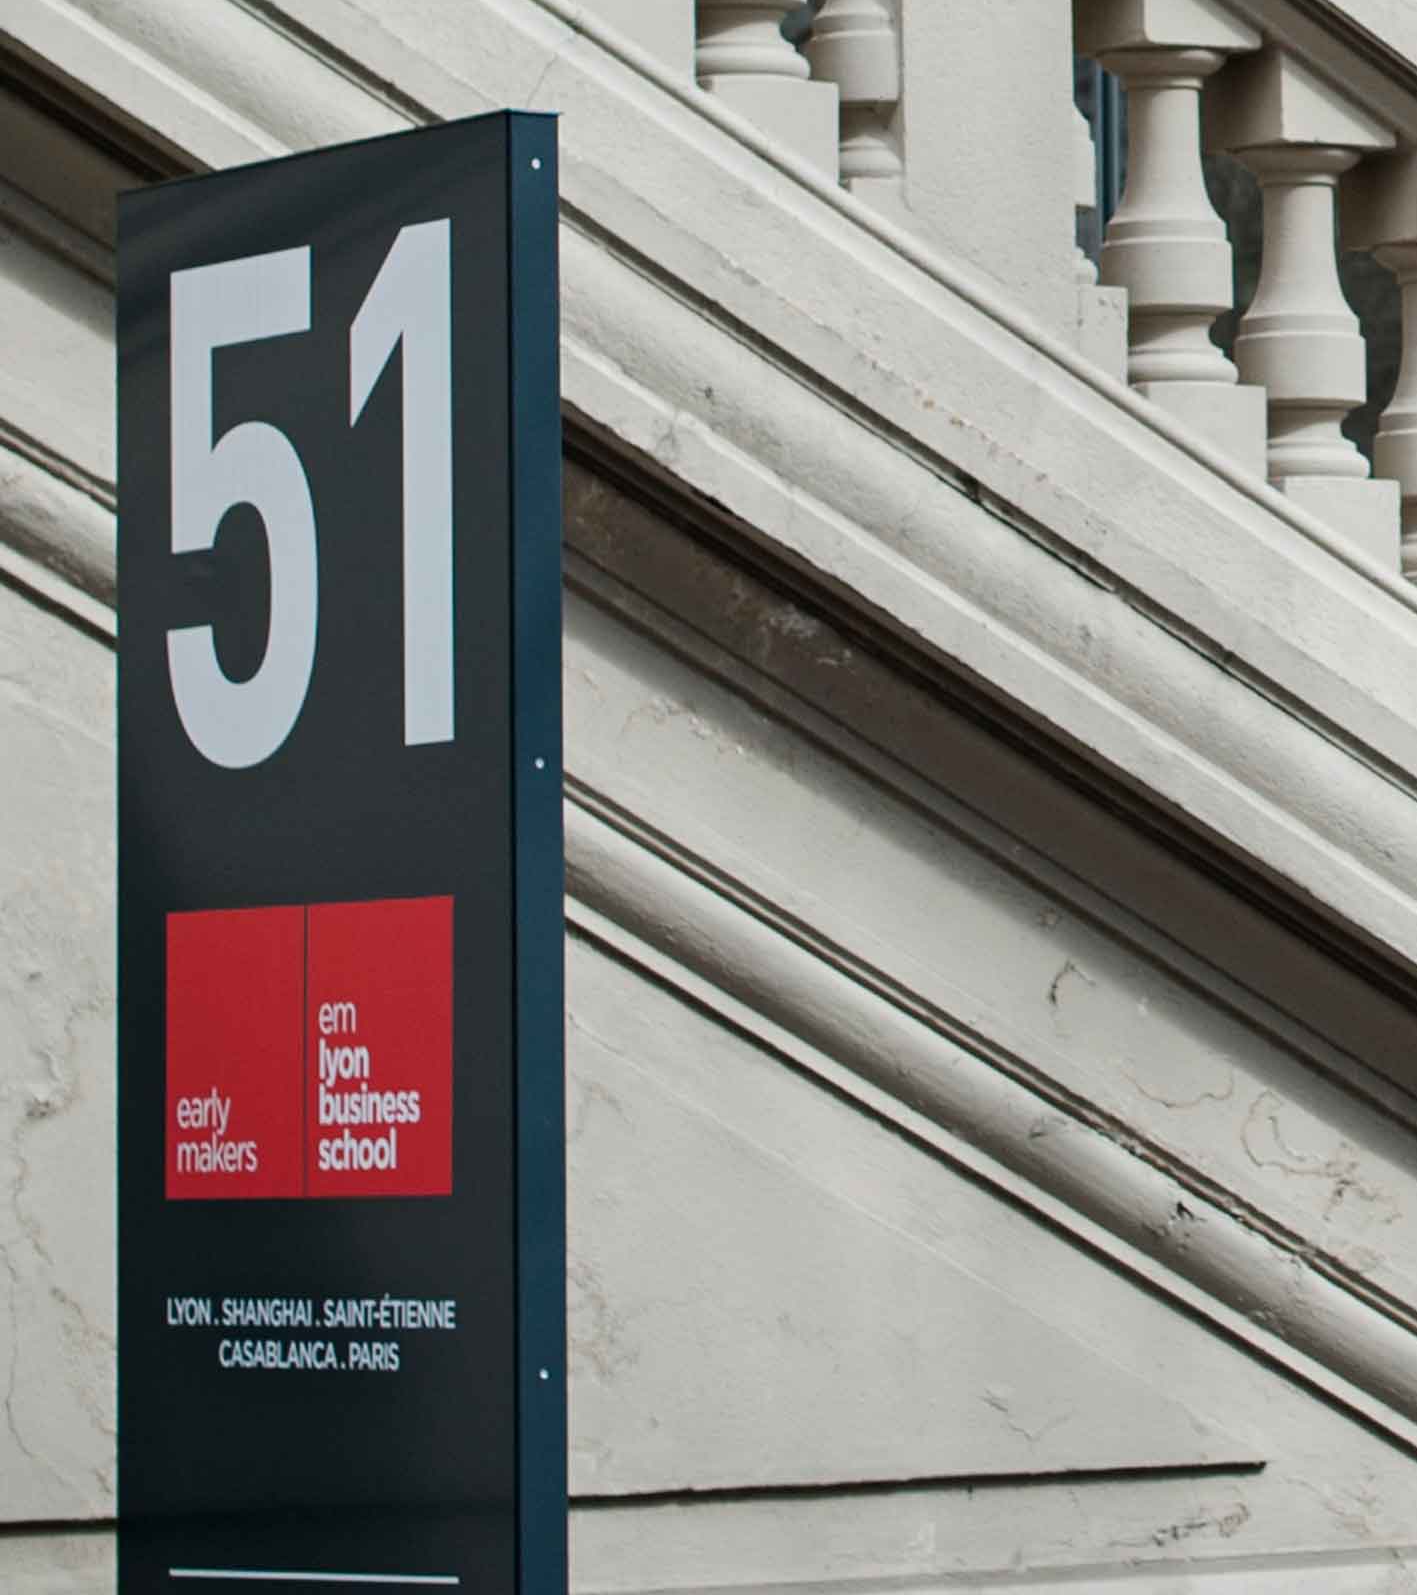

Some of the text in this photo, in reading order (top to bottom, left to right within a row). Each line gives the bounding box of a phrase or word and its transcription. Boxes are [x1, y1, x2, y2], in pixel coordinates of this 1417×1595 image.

[166, 217, 455, 769] 51
[318, 1001, 357, 1035] em
[318, 1038, 370, 1087] lyon
[176, 1087, 231, 1135] early
[319, 1083, 421, 1126] business
[177, 1135, 258, 1173] makers
[318, 1126, 397, 1171] school
[167, 1297, 212, 1326] LYON
[221, 1297, 313, 1328] SHANGHAI
[323, 1293, 457, 1330] SAINT-ÉTIENNE
[218, 1339, 338, 1370] CASABLANCA
[348, 1341, 400, 1371] PARIS
